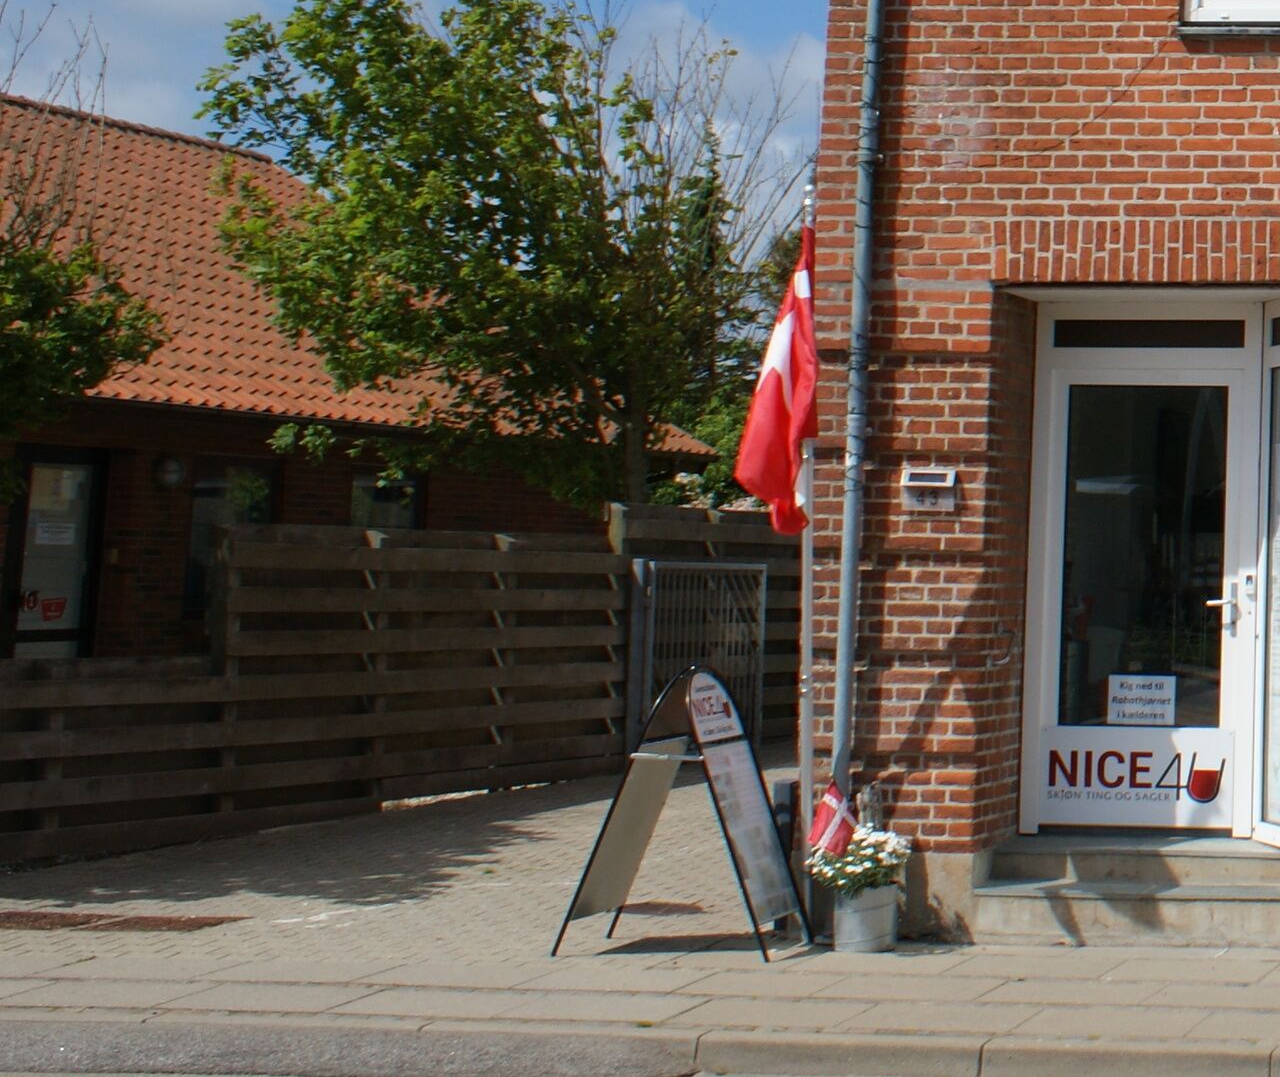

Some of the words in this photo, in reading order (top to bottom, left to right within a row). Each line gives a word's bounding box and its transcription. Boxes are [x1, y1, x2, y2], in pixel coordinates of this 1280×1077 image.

[1136, 681, 1153, 691] ned
[1086, 790, 1112, 801] TING
[1115, 791, 1132, 801] OG
[1135, 791, 1171, 802] SAGER
